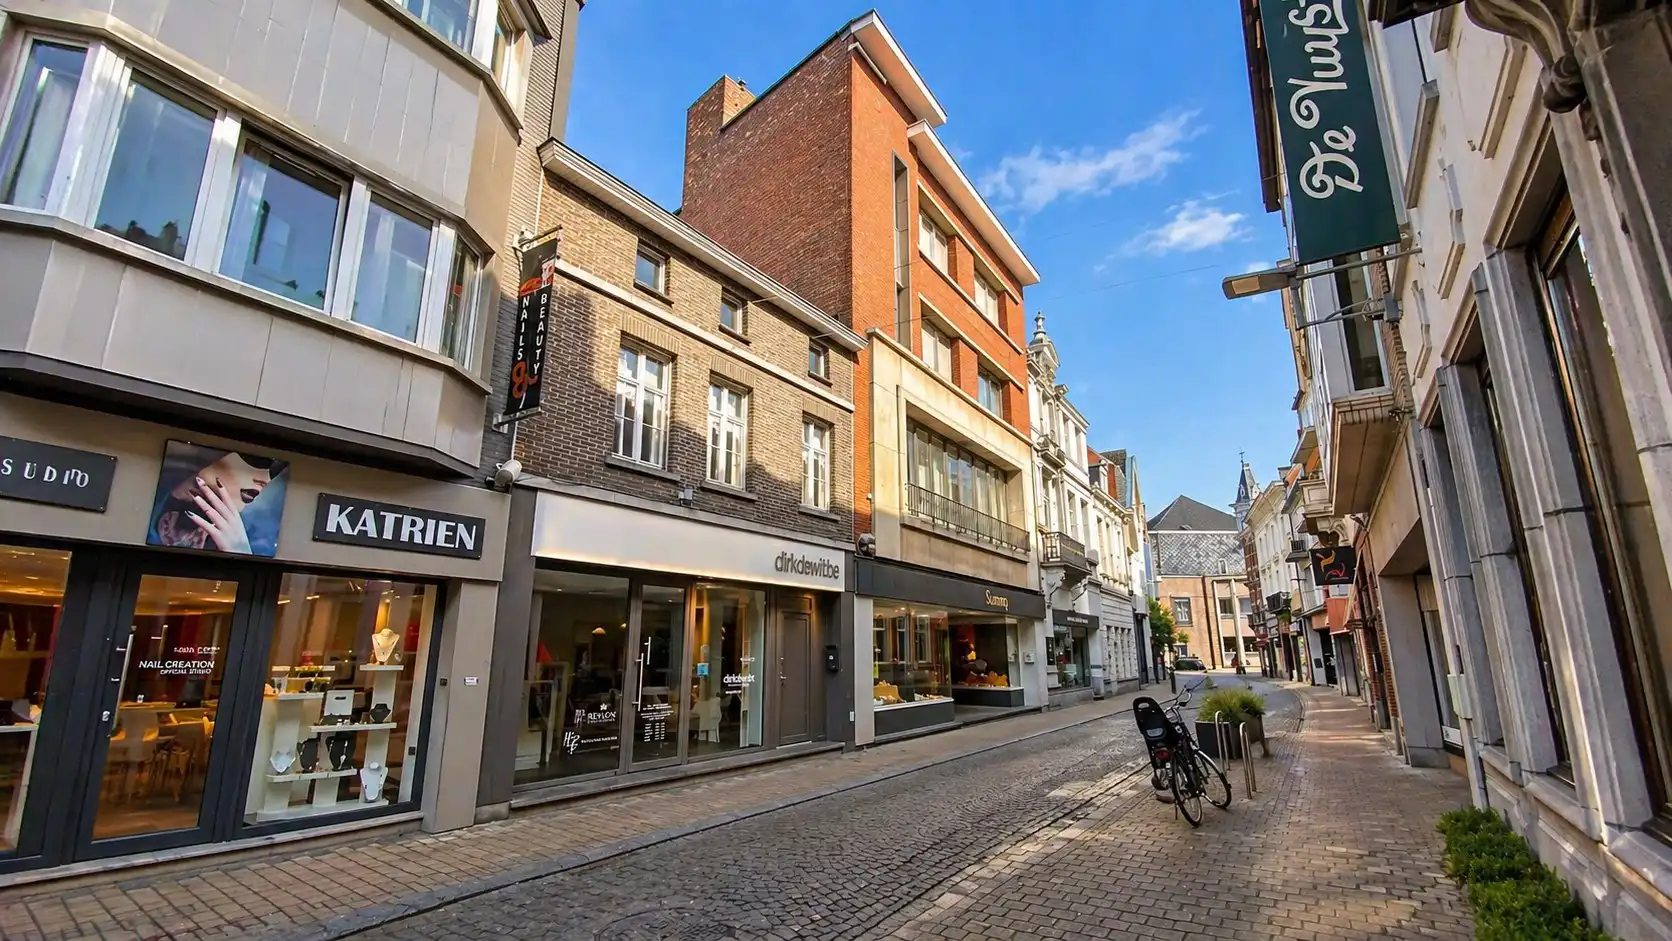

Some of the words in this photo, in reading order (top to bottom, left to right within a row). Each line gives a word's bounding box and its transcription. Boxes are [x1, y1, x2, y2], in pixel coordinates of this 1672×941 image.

[1287, 0, 1350, 129] Vuys
[1299, 125, 1364, 200] De
[517, 295, 530, 361] NAILS
[533, 293, 548, 375] BEAUTY
[325, 503, 477, 550] KATRIEN
[138, 660, 164, 669] NAIL
[164, 660, 216, 669] CREATION
